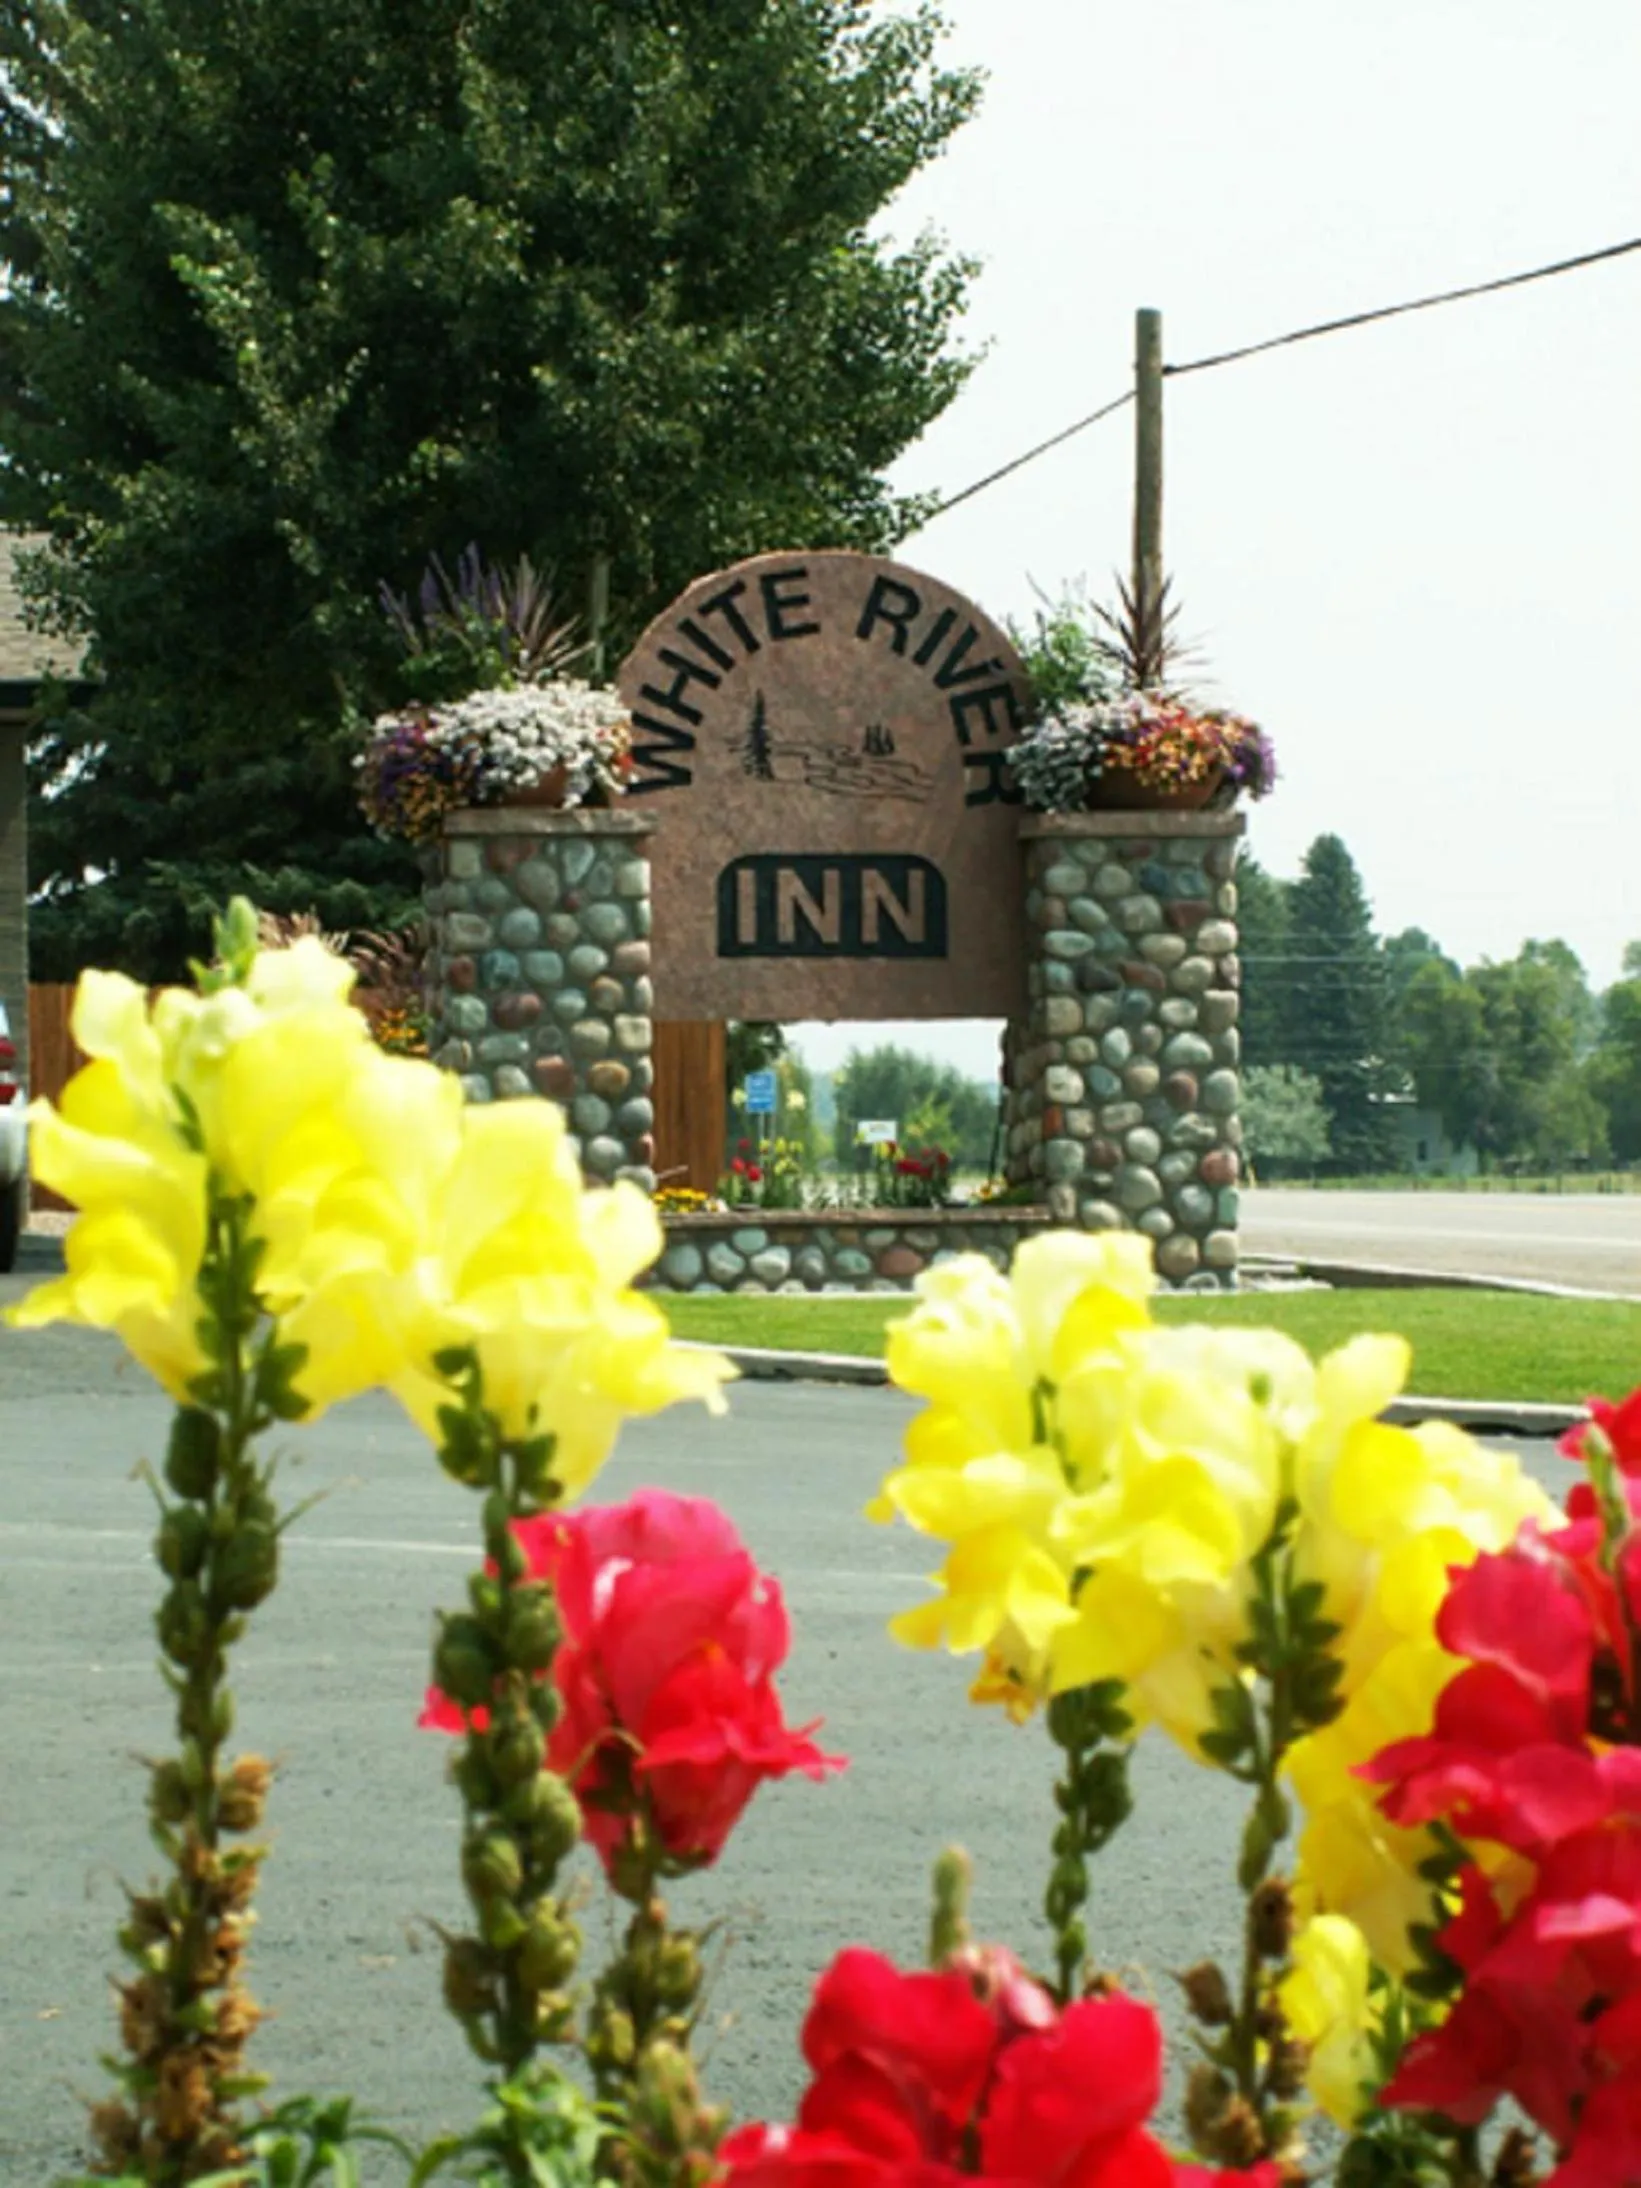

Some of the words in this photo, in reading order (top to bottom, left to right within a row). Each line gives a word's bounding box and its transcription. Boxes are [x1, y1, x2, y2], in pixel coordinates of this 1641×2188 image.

[625, 567, 820, 795] WHITE
[856, 574, 1026, 808] RIVER
[737, 868, 925, 944] INN
